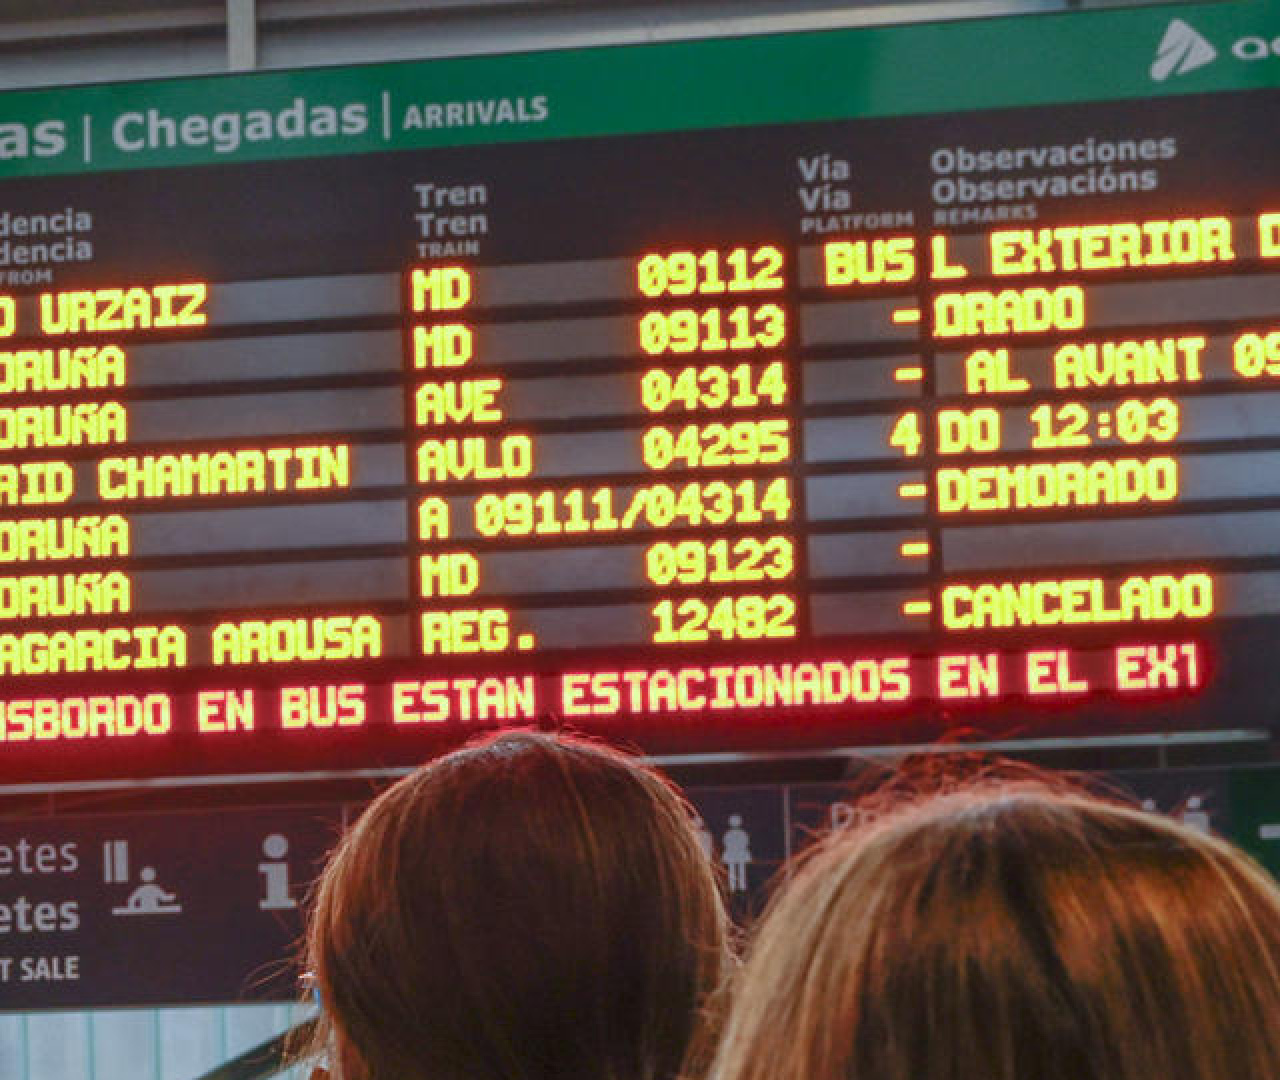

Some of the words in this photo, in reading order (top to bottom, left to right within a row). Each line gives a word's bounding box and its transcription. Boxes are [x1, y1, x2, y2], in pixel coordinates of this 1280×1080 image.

[112, 98, 368, 153] Chegadas
[403, 96, 548, 129] ARRIVALS
[931, 138, 1177, 178] Observaciones
[414, 183, 487, 208] Tren
[932, 165, 1158, 204] Observacións
[415, 213, 488, 237] Tren
[801, 211, 914, 233] PLATFORM
[933, 204, 1038, 225] REMARKS
[417, 240, 479, 258] TRAIN
[40, 284, 206, 334] URZAIZ
[412, 268, 470, 310] MD
[638, 246, 784, 296] 09112
[824, 238, 914, 286] BUS
[990, 218, 1234, 274] EXTERIOR
[414, 324, 472, 368] MD
[640, 304, 784, 354] 09113
[416, 380, 502, 424] AVE
[642, 362, 786, 412] 04314
[966, 350, 1030, 394] AL
[1054, 336, 1206, 388] AVANT
[98, 446, 348, 500] CHAMARTIN
[418, 436, 532, 482] AVLO
[644, 420, 788, 470] 04295
[1030, 398, 1178, 448] 12:03
[212, 616, 382, 664] AROUSA
[422, 610, 534, 654] REG.
[652, 594, 796, 642] 12482
[942, 574, 1212, 628] CANCELADO
[198, 690, 254, 732] EN
[282, 686, 364, 728] BUS
[394, 676, 534, 722] ESTAN
[562, 660, 910, 714] ESTACIONADOS
[940, 654, 998, 698] EN
[1028, 652, 1088, 694] EL
[20, 956, 79, 981] SALE
